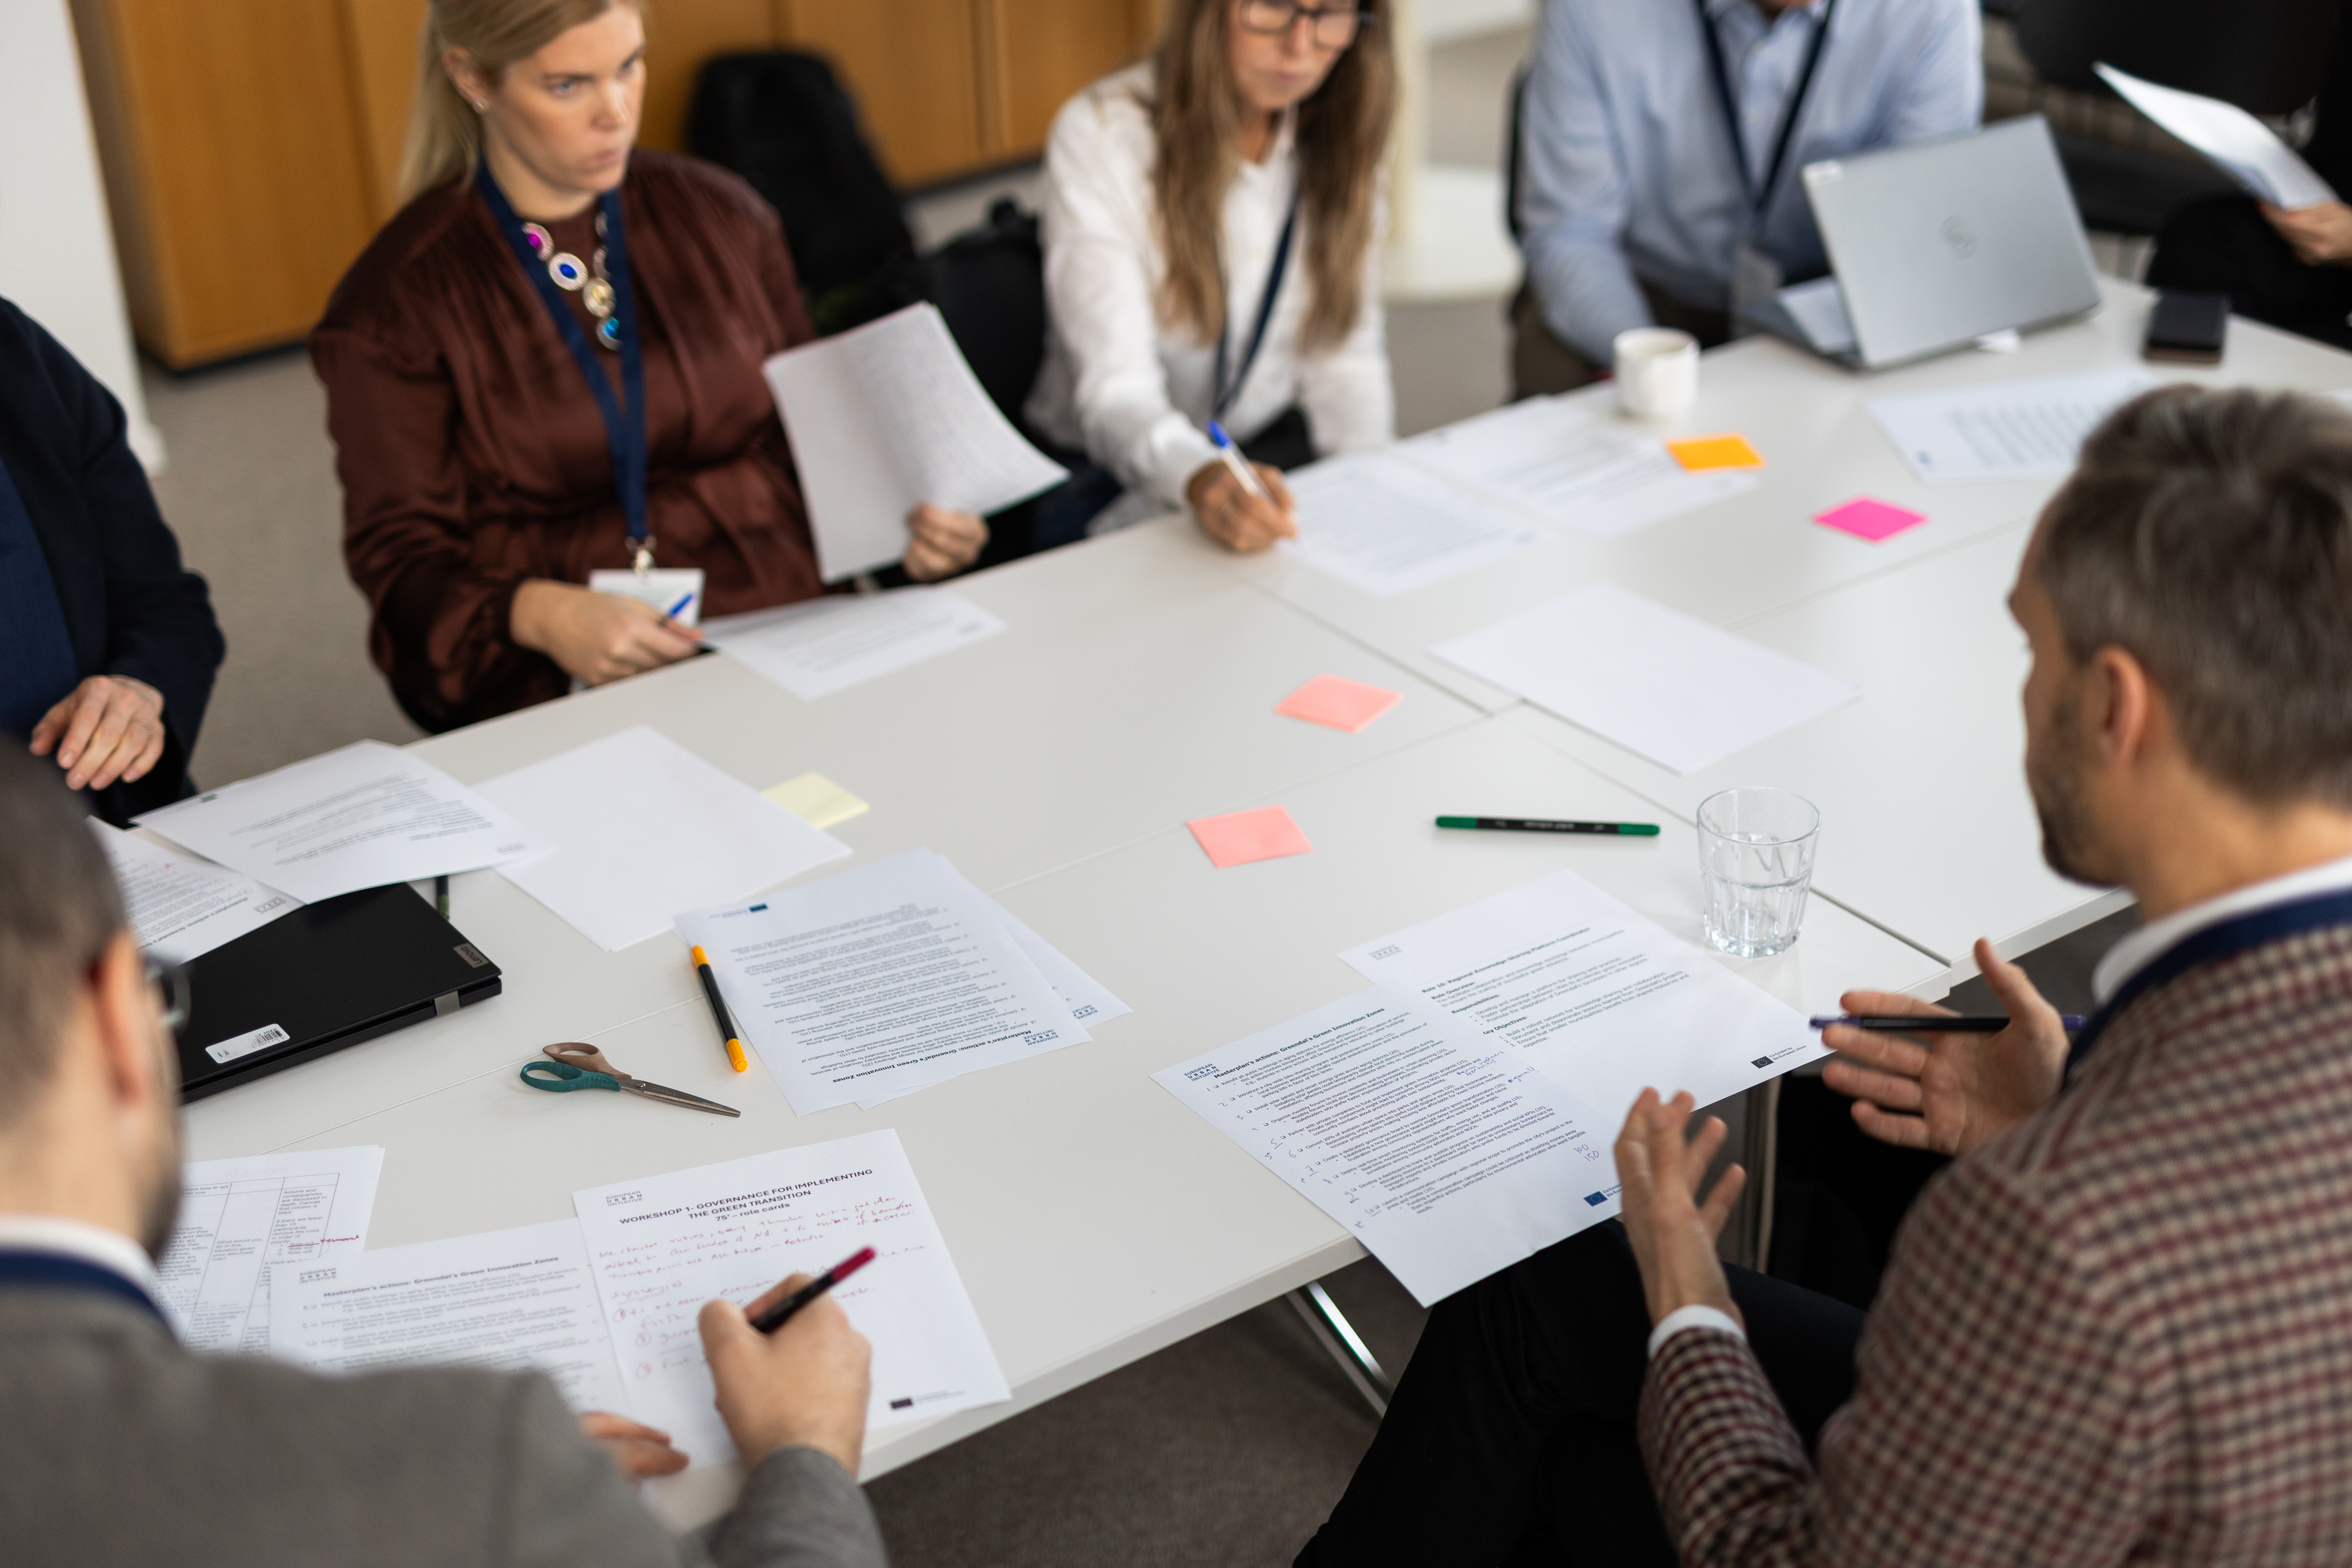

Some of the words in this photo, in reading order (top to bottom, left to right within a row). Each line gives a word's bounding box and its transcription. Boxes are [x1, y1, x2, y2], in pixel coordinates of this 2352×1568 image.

[1451, 994, 1499, 1014] Responsibilities:
[1494, 1016, 1528, 1030] Objectives:
[987, 1030, 1031, 1043] Masterplan’s
[1023, 1029, 1054, 1039] INITIATIVE
[1025, 1032, 1056, 1042] URBAN
[1027, 1035, 1058, 1045] EUROPEAN
[958, 1042, 985, 1051] actions:
[1213, 1061, 1254, 1078] Masterplan’s
[1254, 1051, 1279, 1062] actions:
[1279, 1037, 1313, 1051] Greendal's
[1312, 1029, 1332, 1038] Green
[1332, 1016, 1366, 1030] Innovation
[1365, 1008, 1384, 1017] Zones
[1522, 1037, 1549, 1048] expertise.
[919, 1049, 957, 1061] Greendal's
[1221, 1077, 1238, 1085] Retrofit
[1257, 1061, 1278, 1071] buildings
[1295, 1047, 1313, 1055] districts
[1335, 1030, 1355, 1039] efficiency
[1779, 1049, 1796, 1058] European
[856, 1064, 895, 1076] Innovation
[1184, 1063, 1213, 1076] EUROPEAN
[1187, 1065, 1217, 1078] URBAN
[1191, 1068, 1220, 1081] INITIATIVE
[1237, 1088, 1259, 1098] Introduce
[1264, 1078, 1284, 1087] city-wide
[1282, 1067, 1311, 1079] bike-sharing
[1310, 1059, 1329, 1068] program
[1338, 1042, 1371, 1057] pedestrian-only
[1271, 1114, 1291, 1123] Organize
[1291, 1106, 1309, 1115] monthly
[1309, 1099, 1326, 1107] forums
[1347, 1082, 1368, 1091] residents
[1376, 1068, 1400, 1079] businesses
[1418, 1052, 1437, 1062] planning
[1288, 1149, 1297, 1158] 6
[1573, 1144, 1589, 1154] 100
[1584, 1151, 1599, 1162] 150
[606, 1190, 640, 1200] EUROPEAN
[606, 1193, 642, 1203] URBAN
[607, 1196, 643, 1206] INITIATIVE
[619, 1208, 681, 1223] WORKSHOP
[696, 1190, 769, 1209] GOVERNANCE
[794, 1169, 872, 1189] IMPLEMENTING
[711, 1203, 746, 1213] GREEN
[749, 1190, 811, 1206] TRANSITION
[761, 1203, 790, 1212] cards
